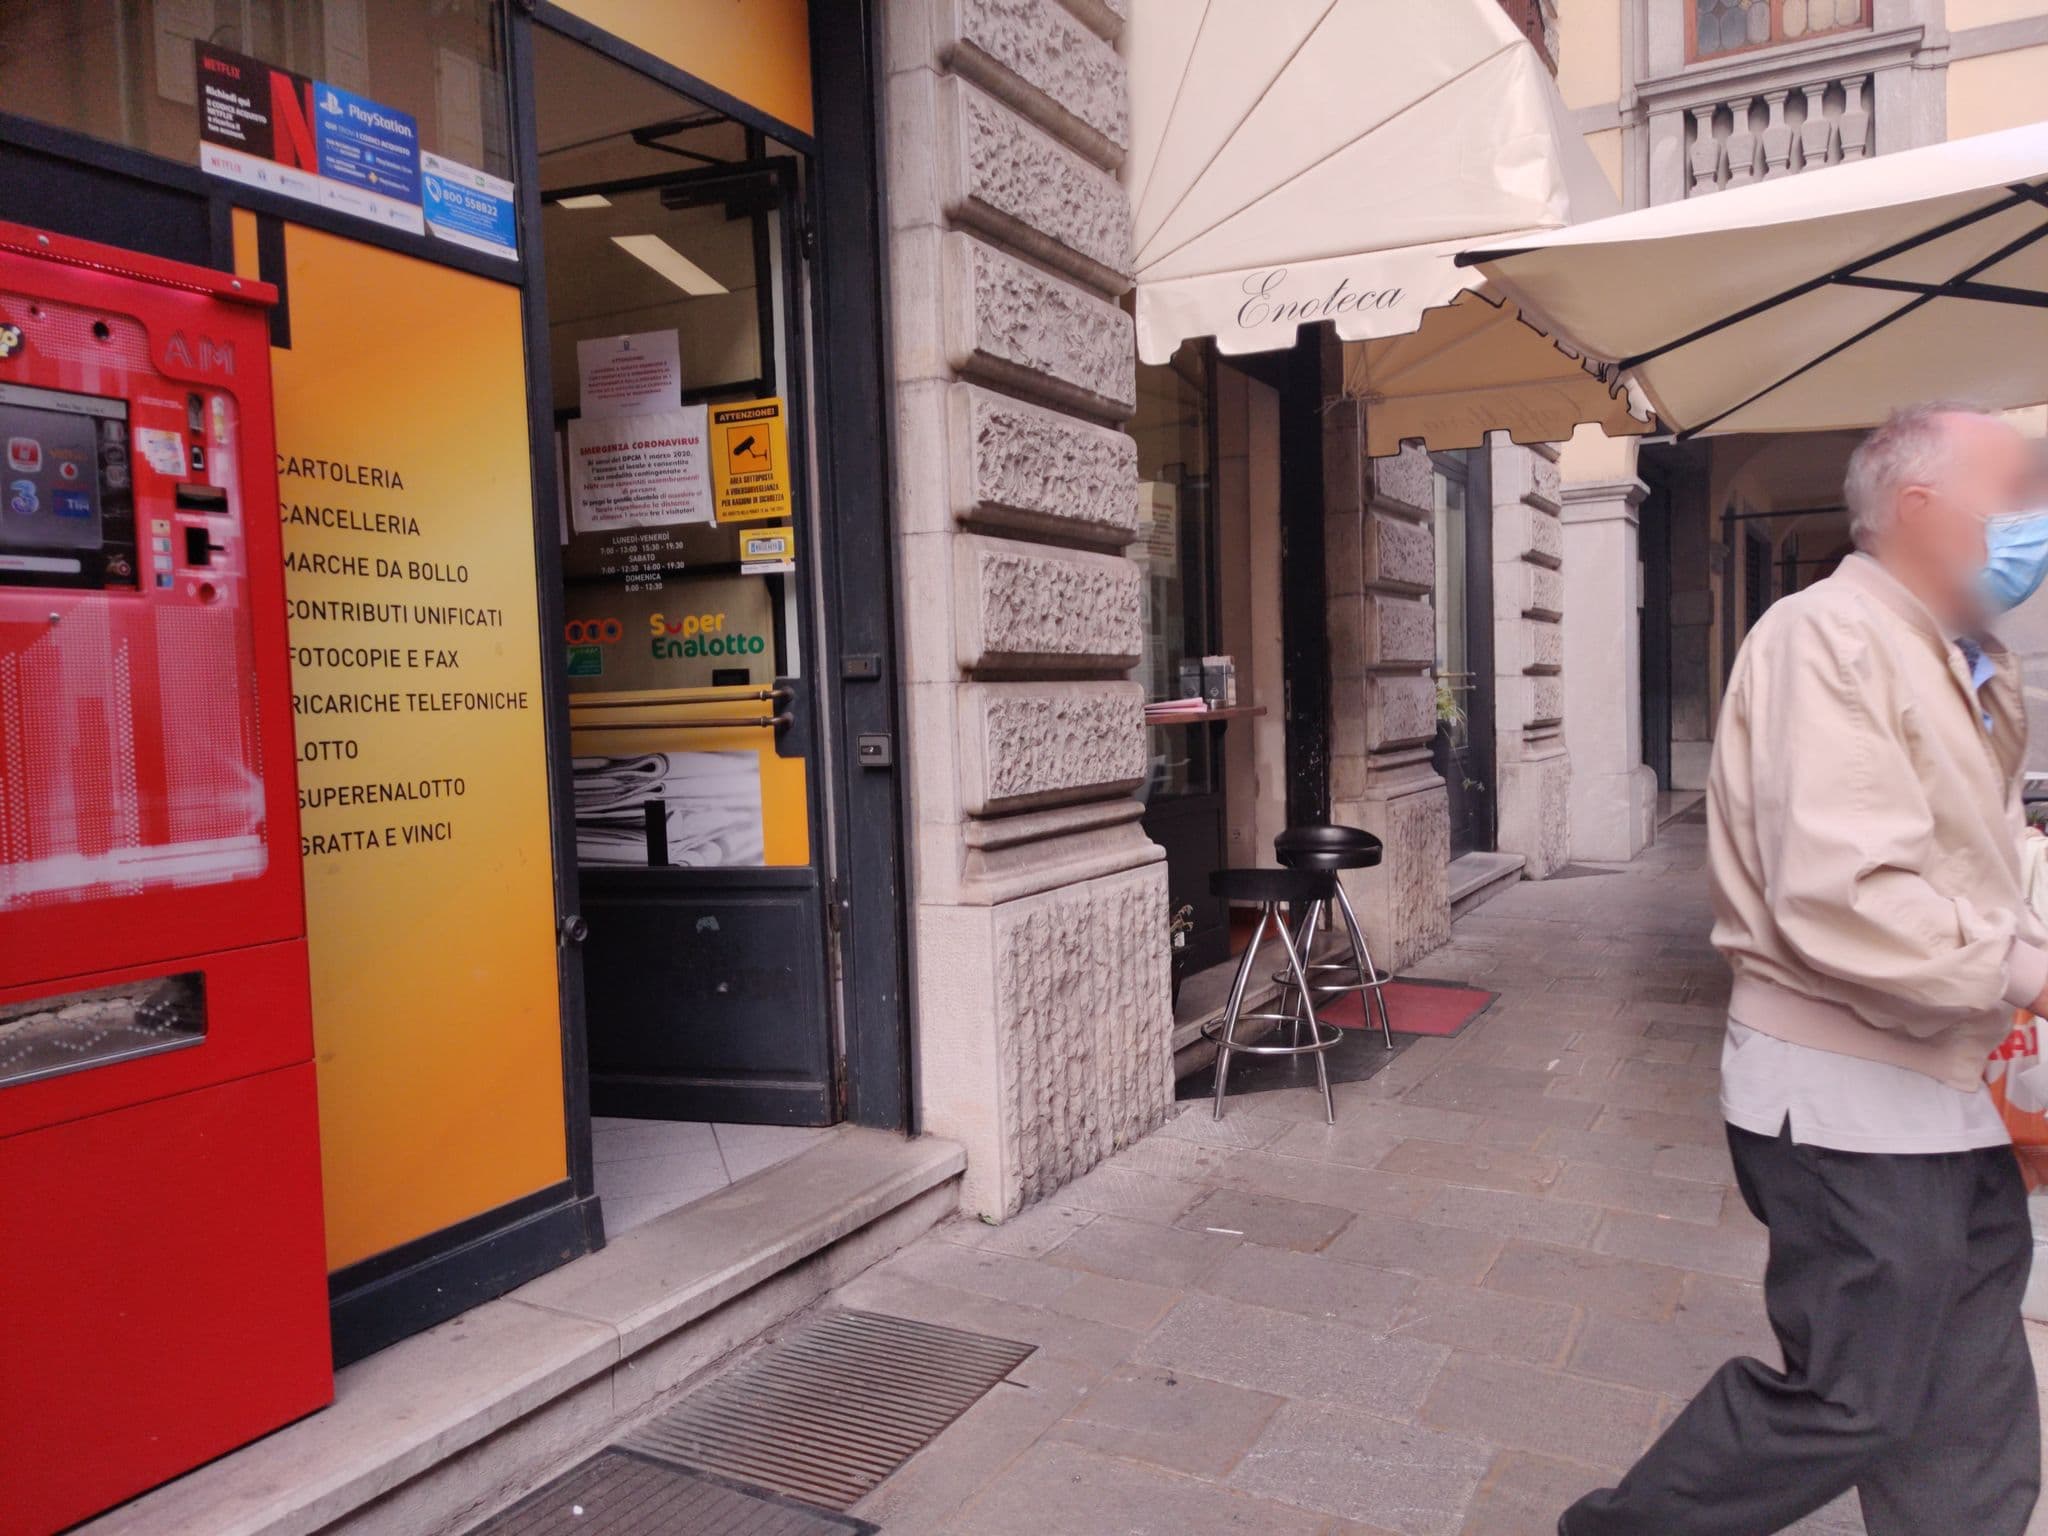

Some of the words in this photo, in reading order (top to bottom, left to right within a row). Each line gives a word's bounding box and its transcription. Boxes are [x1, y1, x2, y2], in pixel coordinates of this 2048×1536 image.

[203, 57, 240, 79] NETFLIX
[210, 157, 241, 173] NETFLIX
[443, 189, 463, 205] 800
[1237, 268, 1405, 328] Enoteca
[719, 408, 775, 422] ATTENZIONE!
[580, 444, 629, 456] EMERGENZA
[632, 437, 699, 449] CORONAVIRUS
[276, 454, 404, 490] CARTOLERIA
[279, 502, 420, 536] CANCELLERIA
[284, 552, 369, 576] MARCHE
[376, 559, 403, 579] DA
[409, 561, 468, 583] BOLLO
[628, 554, 655, 562] SABATO
[625, 573, 661, 582] DOMENICA
[286, 599, 408, 623] CONTRIBUTI
[414, 606, 502, 627] UNIFICATI
[650, 612, 725, 637] Super
[290, 647, 401, 667] FOTOCOPIE
[408, 649, 418, 667] E
[425, 650, 459, 668] FAX
[652, 634, 765, 659] Enalotto
[292, 694, 400, 714] RICARICHE
[406, 691, 528, 712] TELEFONICHE
[298, 778, 465, 809] SUPERENALOTTO
[301, 830, 379, 856] GRATTA
[385, 828, 396, 847] E
[402, 822, 452, 844] VINCI
